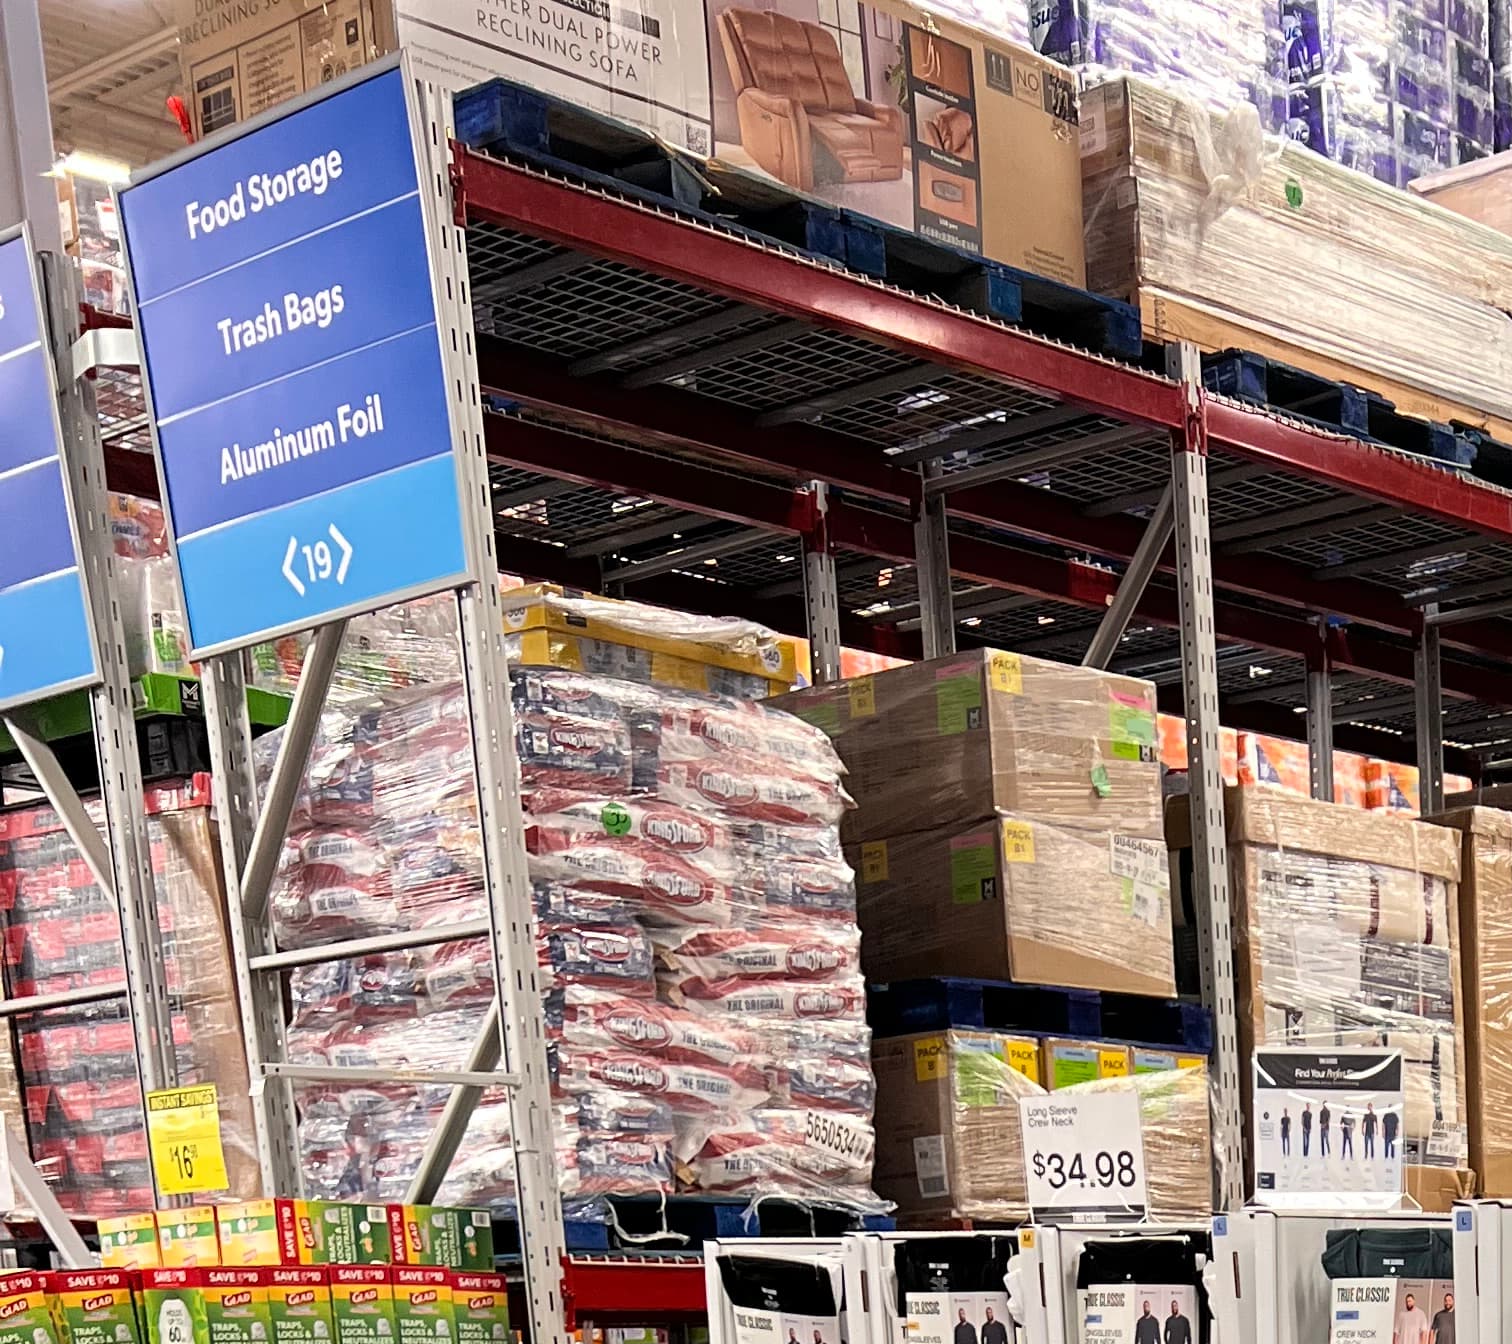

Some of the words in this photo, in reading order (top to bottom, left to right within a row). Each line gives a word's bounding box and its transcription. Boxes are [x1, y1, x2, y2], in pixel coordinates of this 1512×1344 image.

[477, 9, 583, 62] RECLINING
[589, 50, 638, 82] SOFA
[539, 6, 588, 40] DUAL
[594, 20, 663, 64] POWER
[1016, 68, 1040, 92] NO
[186, 187, 245, 239] Food
[250, 148, 343, 213] Storage
[218, 310, 281, 356] Trash
[287, 281, 345, 339] Bags
[219, 418, 335, 485] Aluminum
[338, 395, 384, 444] Foil
[302, 546, 333, 582] 19
[993, 656, 1018, 671] PACK
[1006, 828, 1031, 841] PACK
[917, 1047, 942, 1058] PACK
[1011, 1049, 1033, 1061] PACK
[1103, 1058, 1125, 1071] PACK
[1027, 1106, 1051, 1120] Long
[1054, 1105, 1078, 1117] Sleeve
[1028, 1117, 1050, 1128] Crew
[1052, 1116, 1075, 1127] Neck
[807, 1111, 856, 1155] 5650534
[1032, 1149, 1136, 1189] $34.98
[1337, 1287, 1354, 1302] TRUE
[1356, 1286, 1389, 1303] CLASSIC
